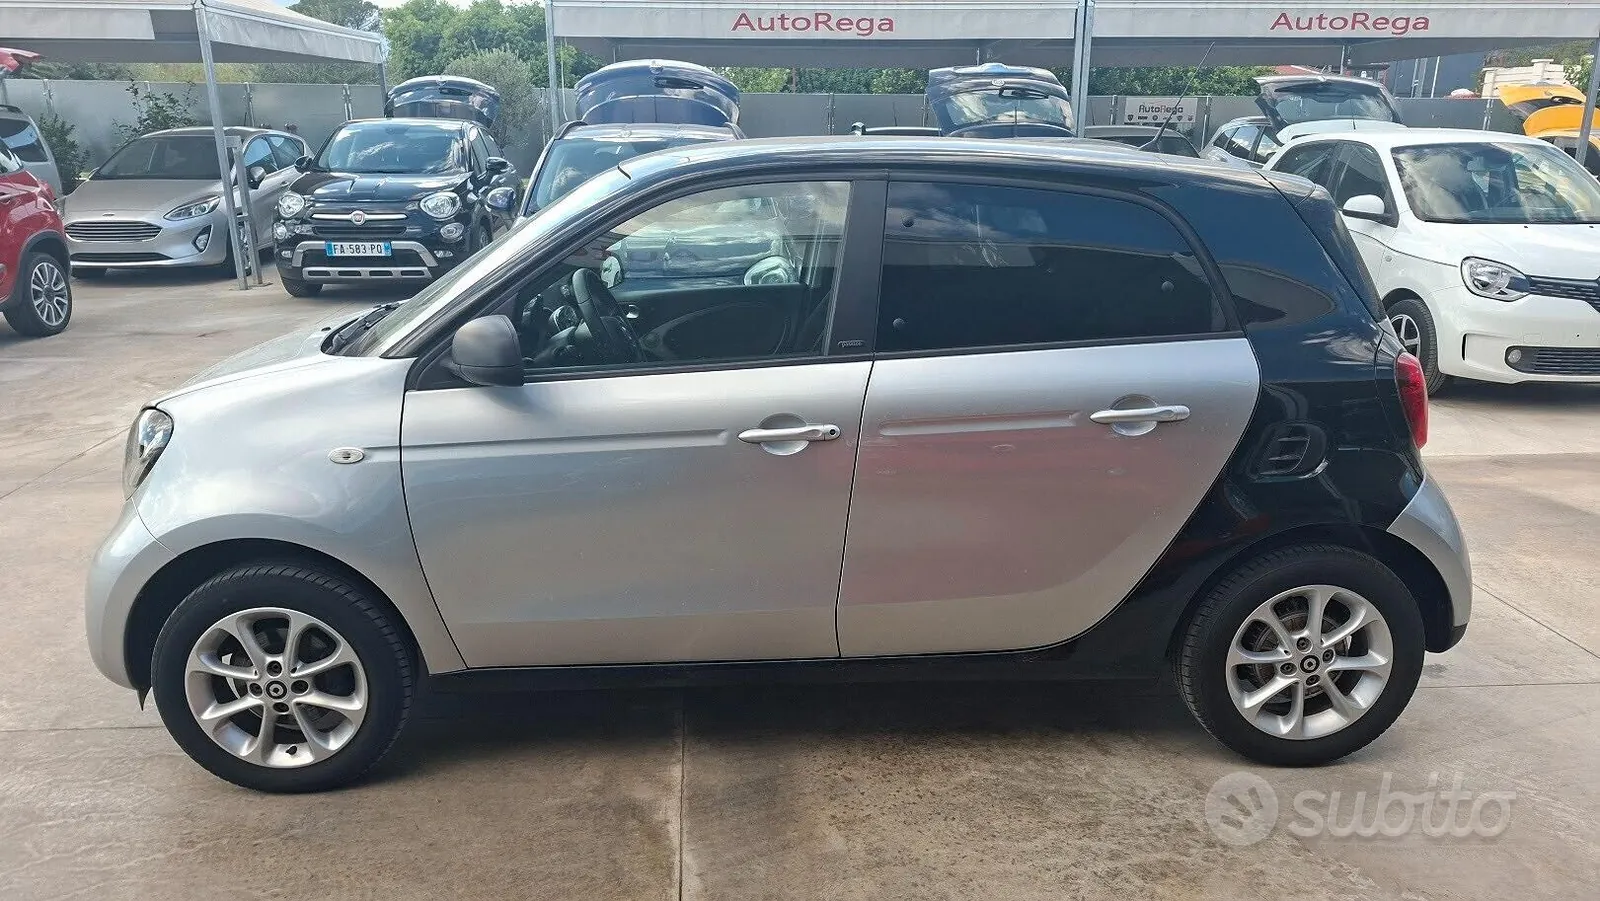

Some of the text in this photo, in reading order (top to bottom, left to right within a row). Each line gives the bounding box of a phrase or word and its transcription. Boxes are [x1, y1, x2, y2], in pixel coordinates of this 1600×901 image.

[731, 12, 894, 37] AutoRega
[1270, 12, 1430, 36] AutoRega
[1138, 104, 1184, 115] AutoRega
